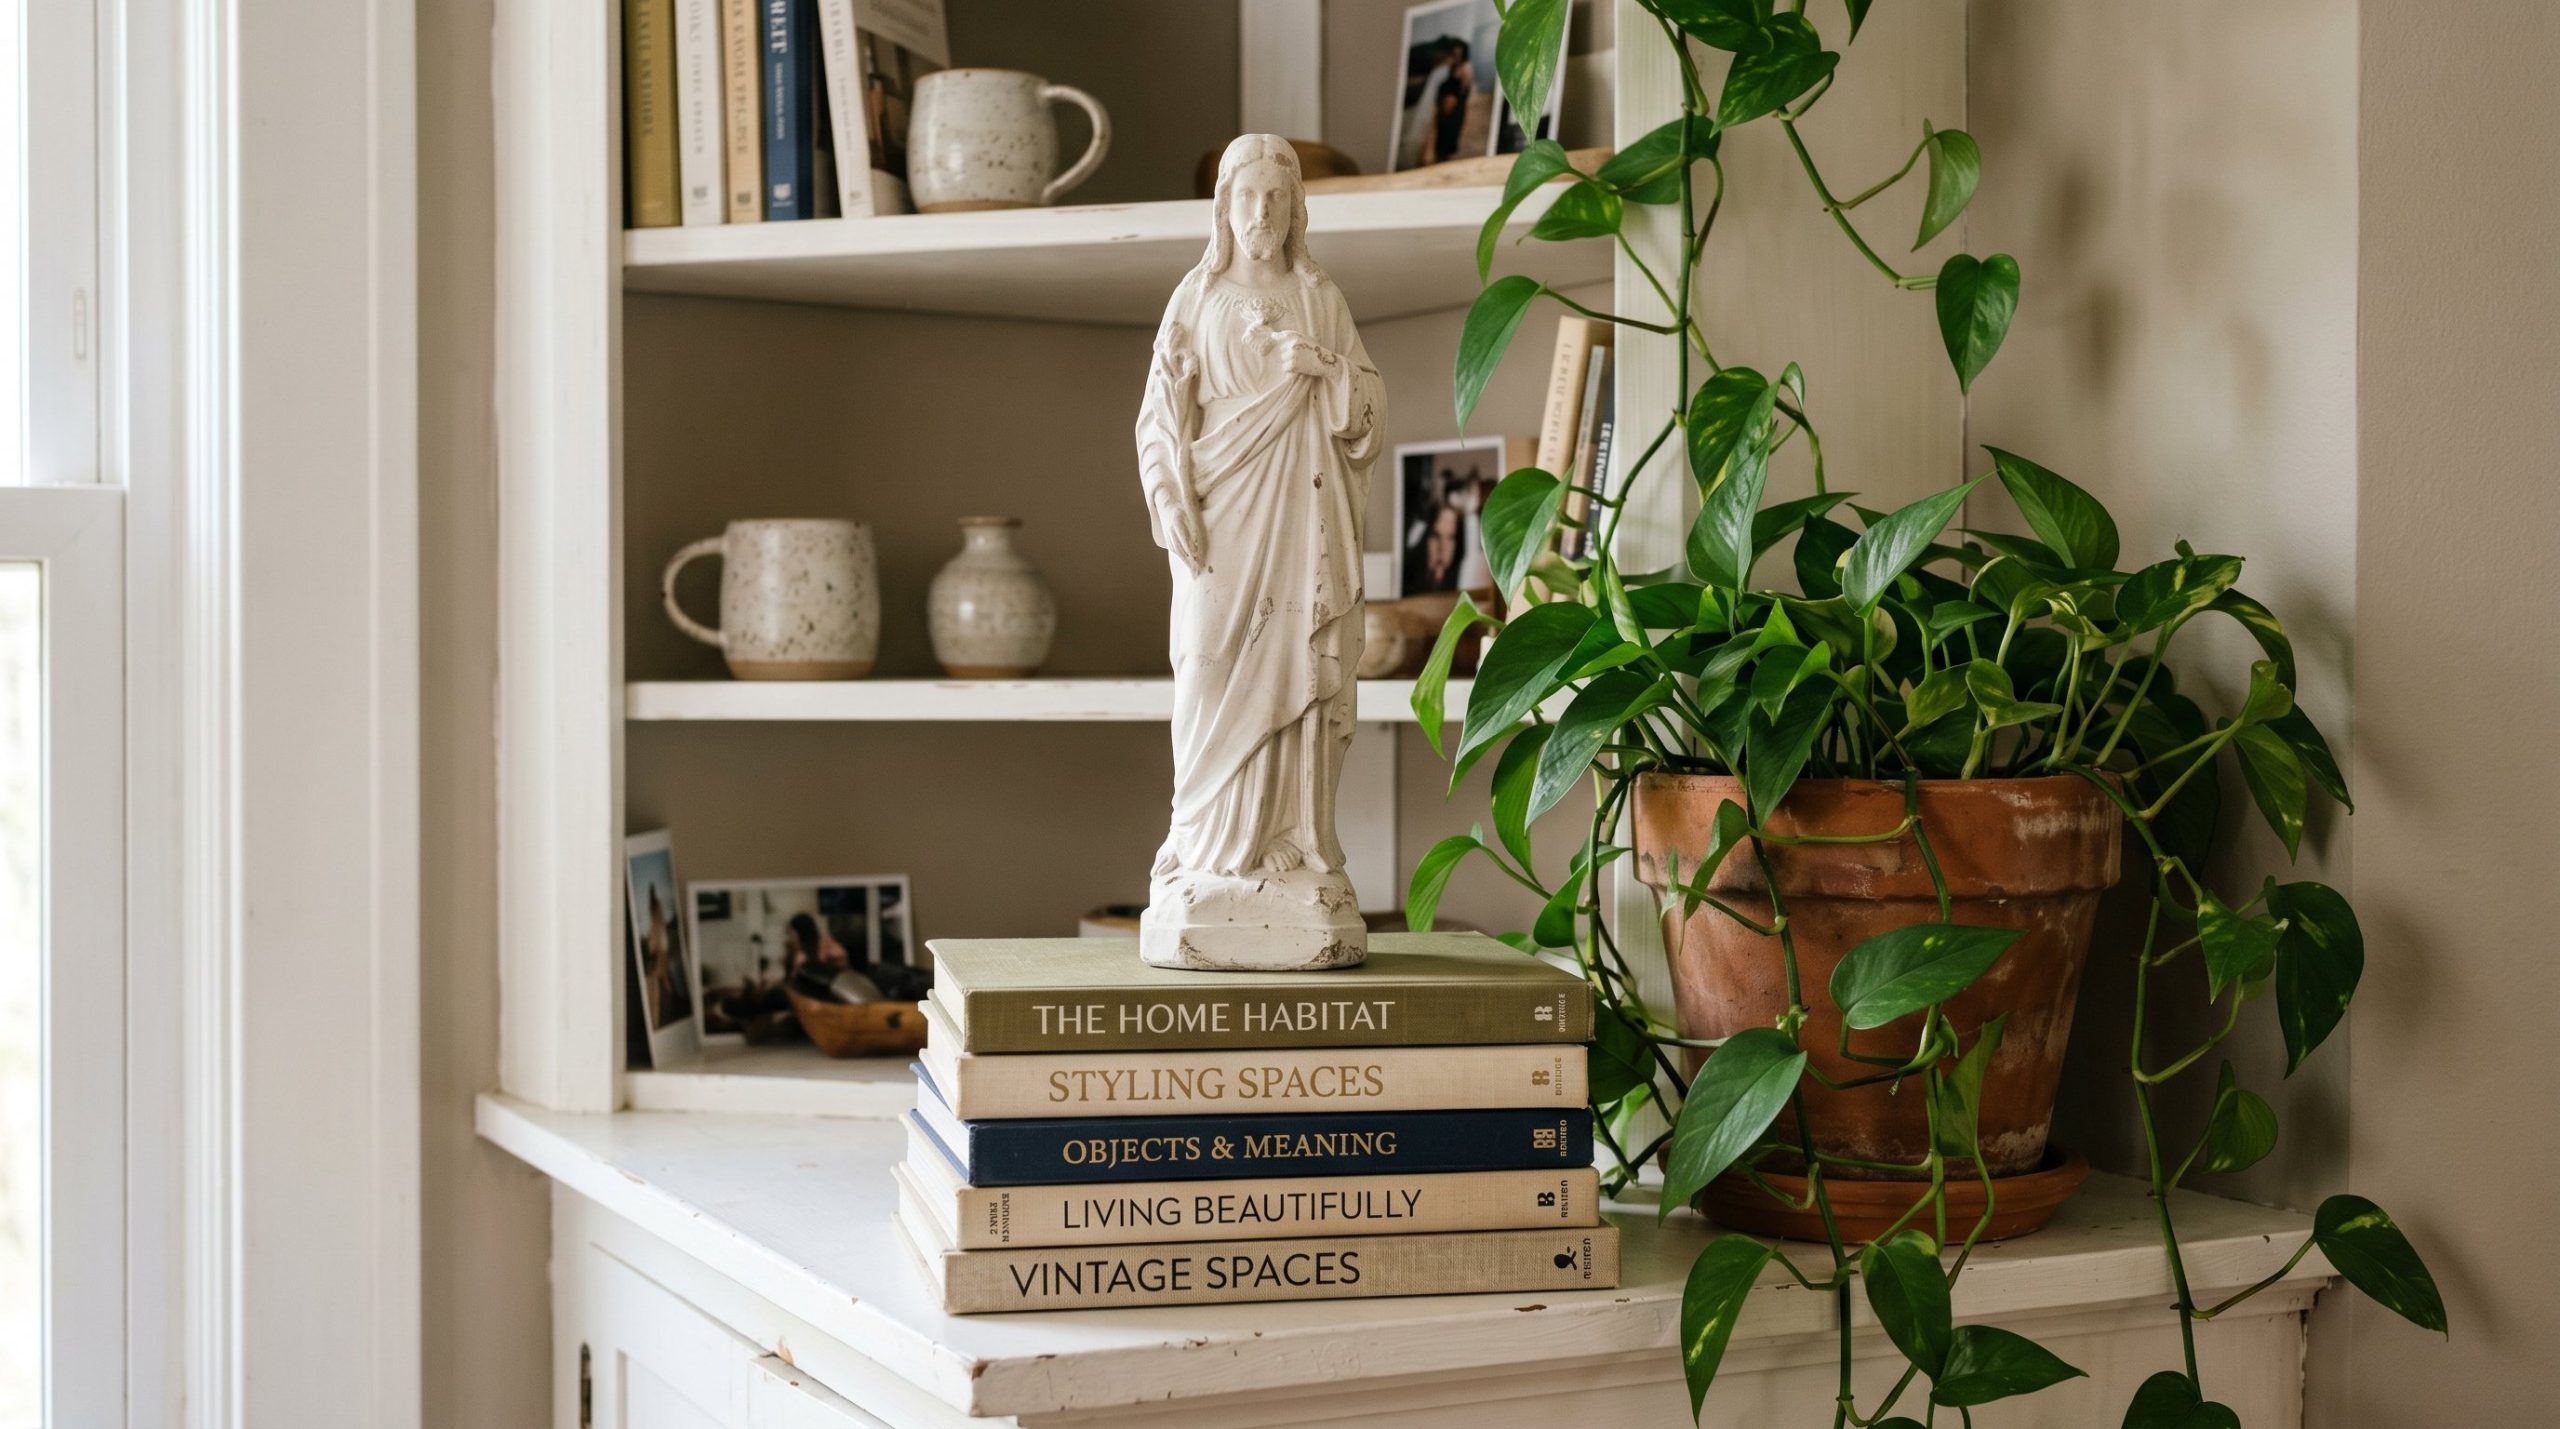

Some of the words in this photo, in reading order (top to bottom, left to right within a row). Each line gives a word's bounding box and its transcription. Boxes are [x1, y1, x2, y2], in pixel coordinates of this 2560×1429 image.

[1032, 1004, 1106, 1035] THE
[1119, 1003, 1230, 1034] HOME
[1244, 1001, 1396, 1032] HABITAT
[1049, 1067, 1226, 1103] STYLING
[1238, 1064, 1384, 1099] SPACES
[1062, 1136, 1201, 1169] OBJECTS
[1211, 1135, 1235, 1160] &
[1243, 1131, 1397, 1159] MEANING
[1064, 1197, 1181, 1229] LIVING
[1194, 1189, 1422, 1225] BEAUTIFULLY
[1009, 1257, 1192, 1297] VINTAGE
[1206, 1251, 1360, 1290] SPACES
